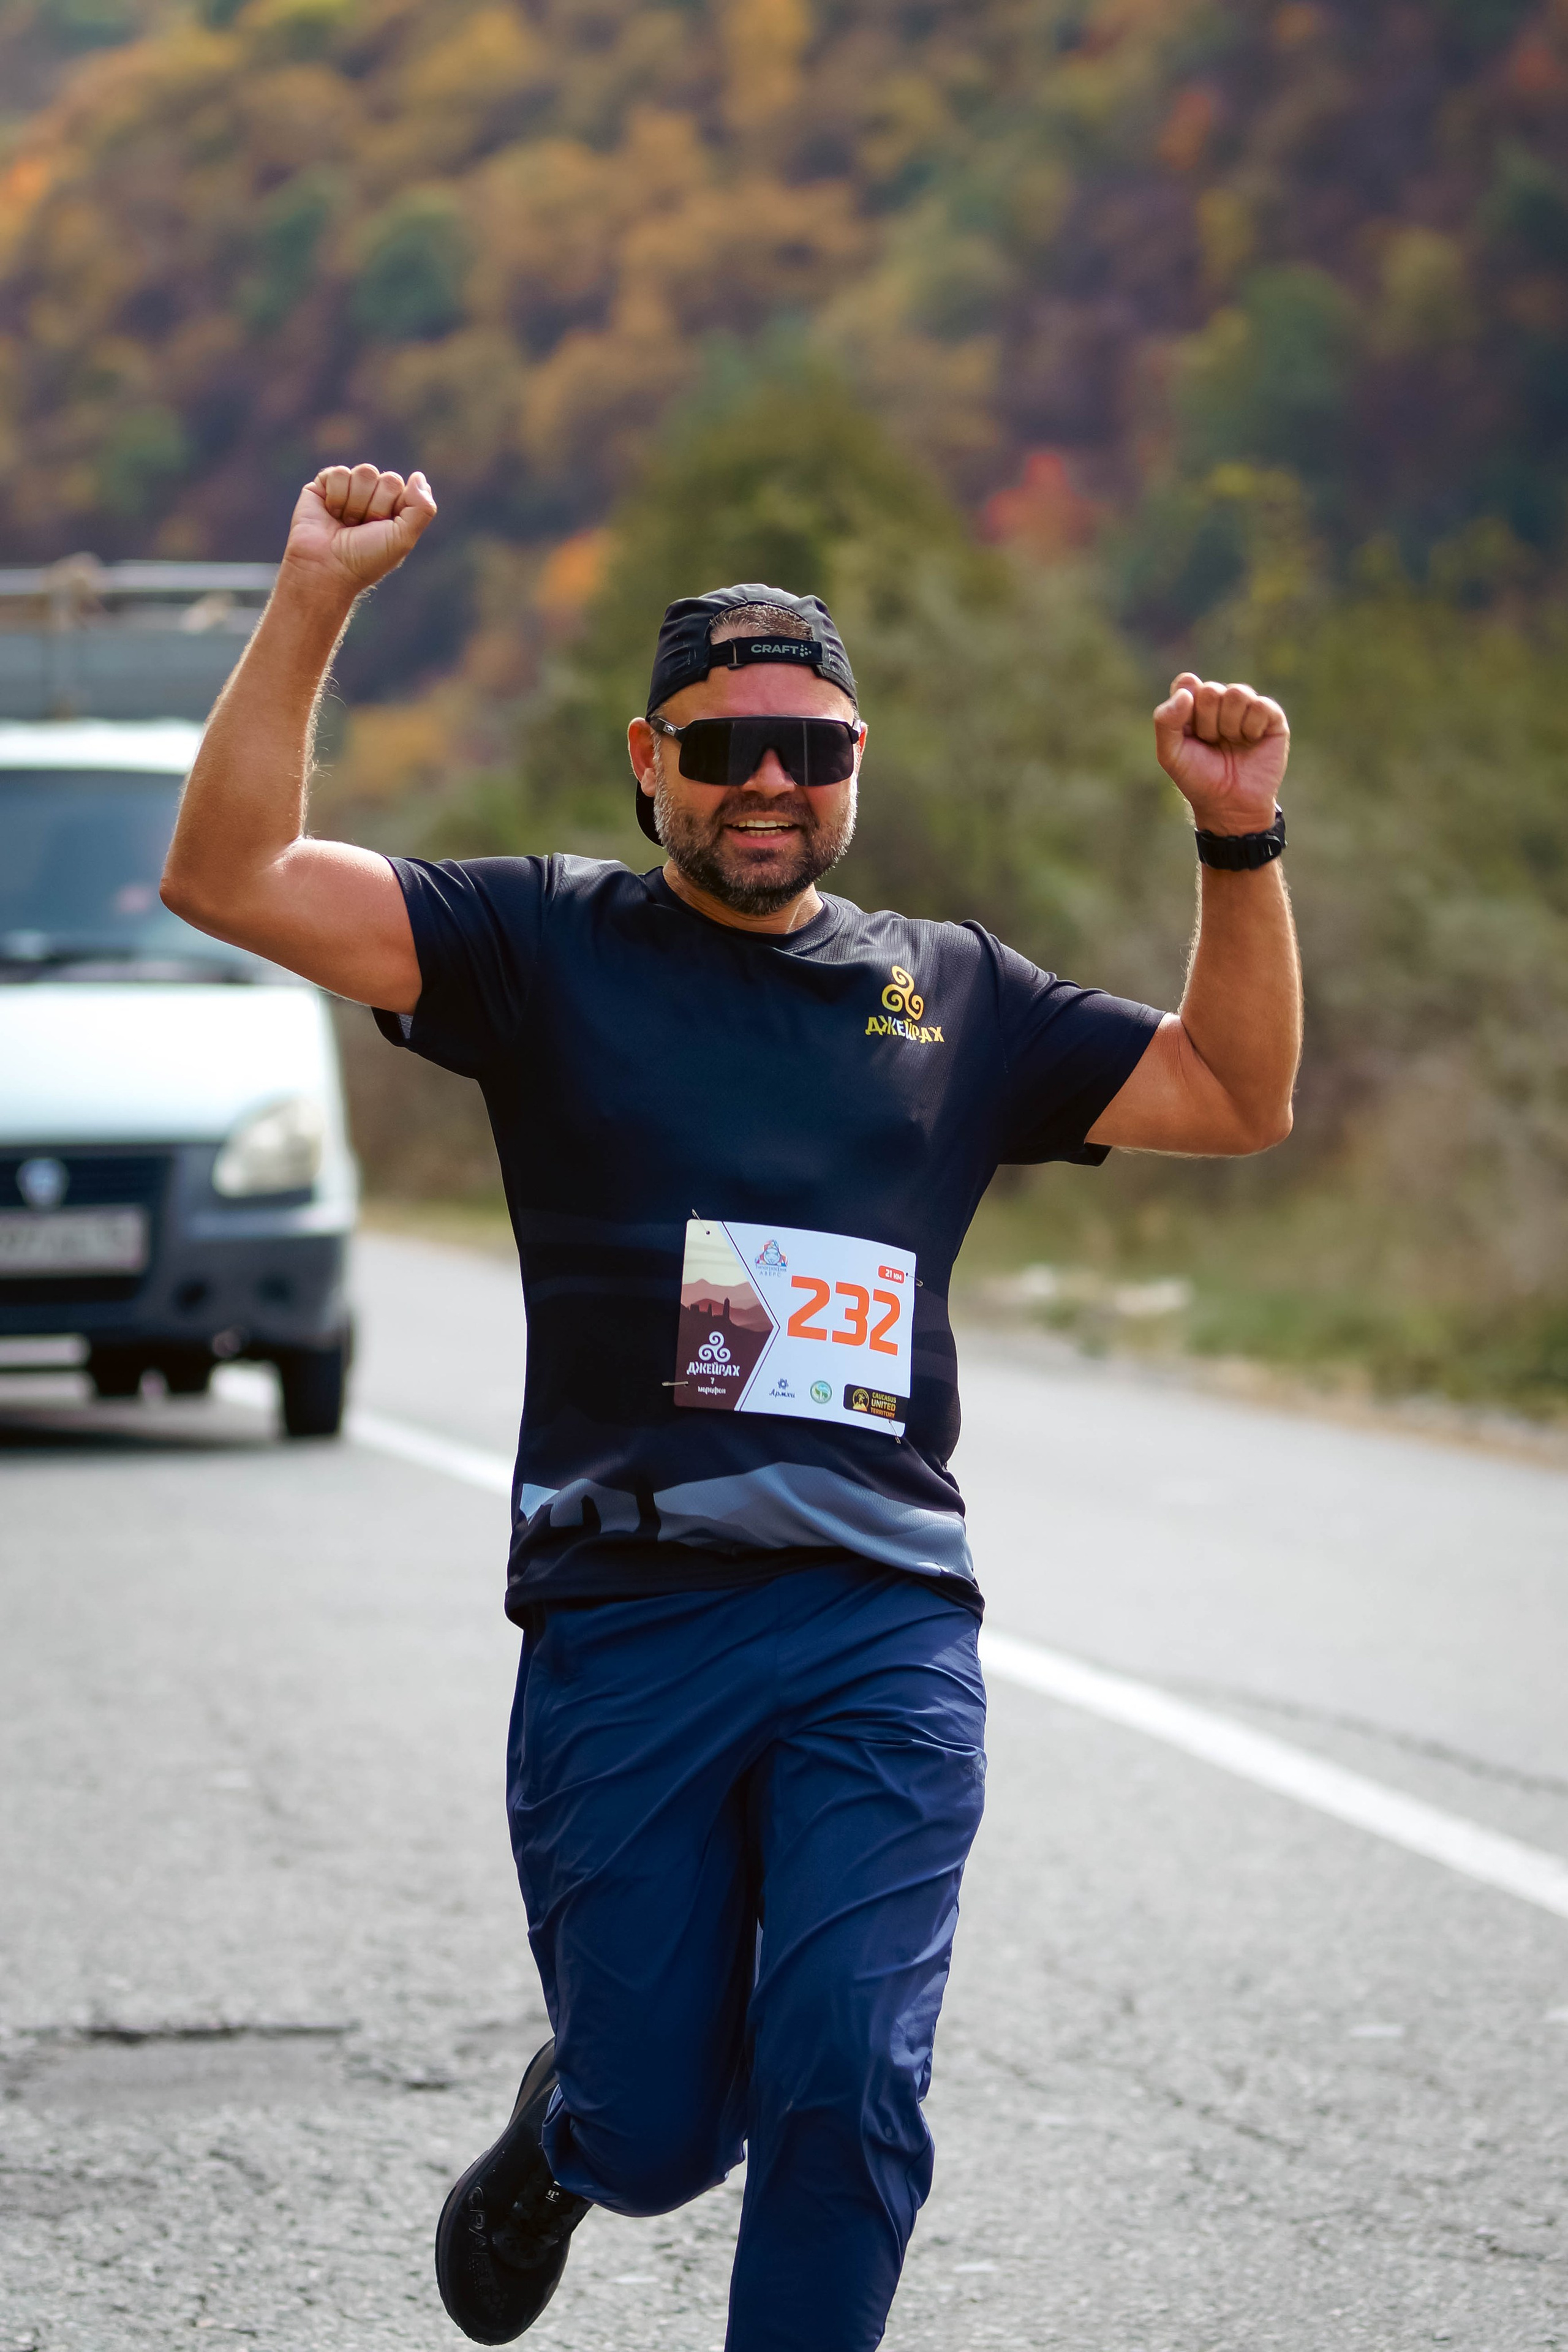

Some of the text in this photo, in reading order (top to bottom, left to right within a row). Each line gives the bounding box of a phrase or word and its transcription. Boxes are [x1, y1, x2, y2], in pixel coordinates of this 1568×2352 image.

[751, 644, 799, 654] CRAFT
[865, 1015, 944, 1043] ДЖЕЙРАХ
[885, 1268, 892, 1278] 21
[787, 1275, 901, 1357] 232
[687, 1361, 740, 1377] ДЖЕЙРАХ
[698, 1385, 726, 1395] марафон
[872, 1392, 897, 1404] CAUCASUS
[871, 1398, 896, 1411] UNITED
[870, 1407, 895, 1418] TERRITORY
